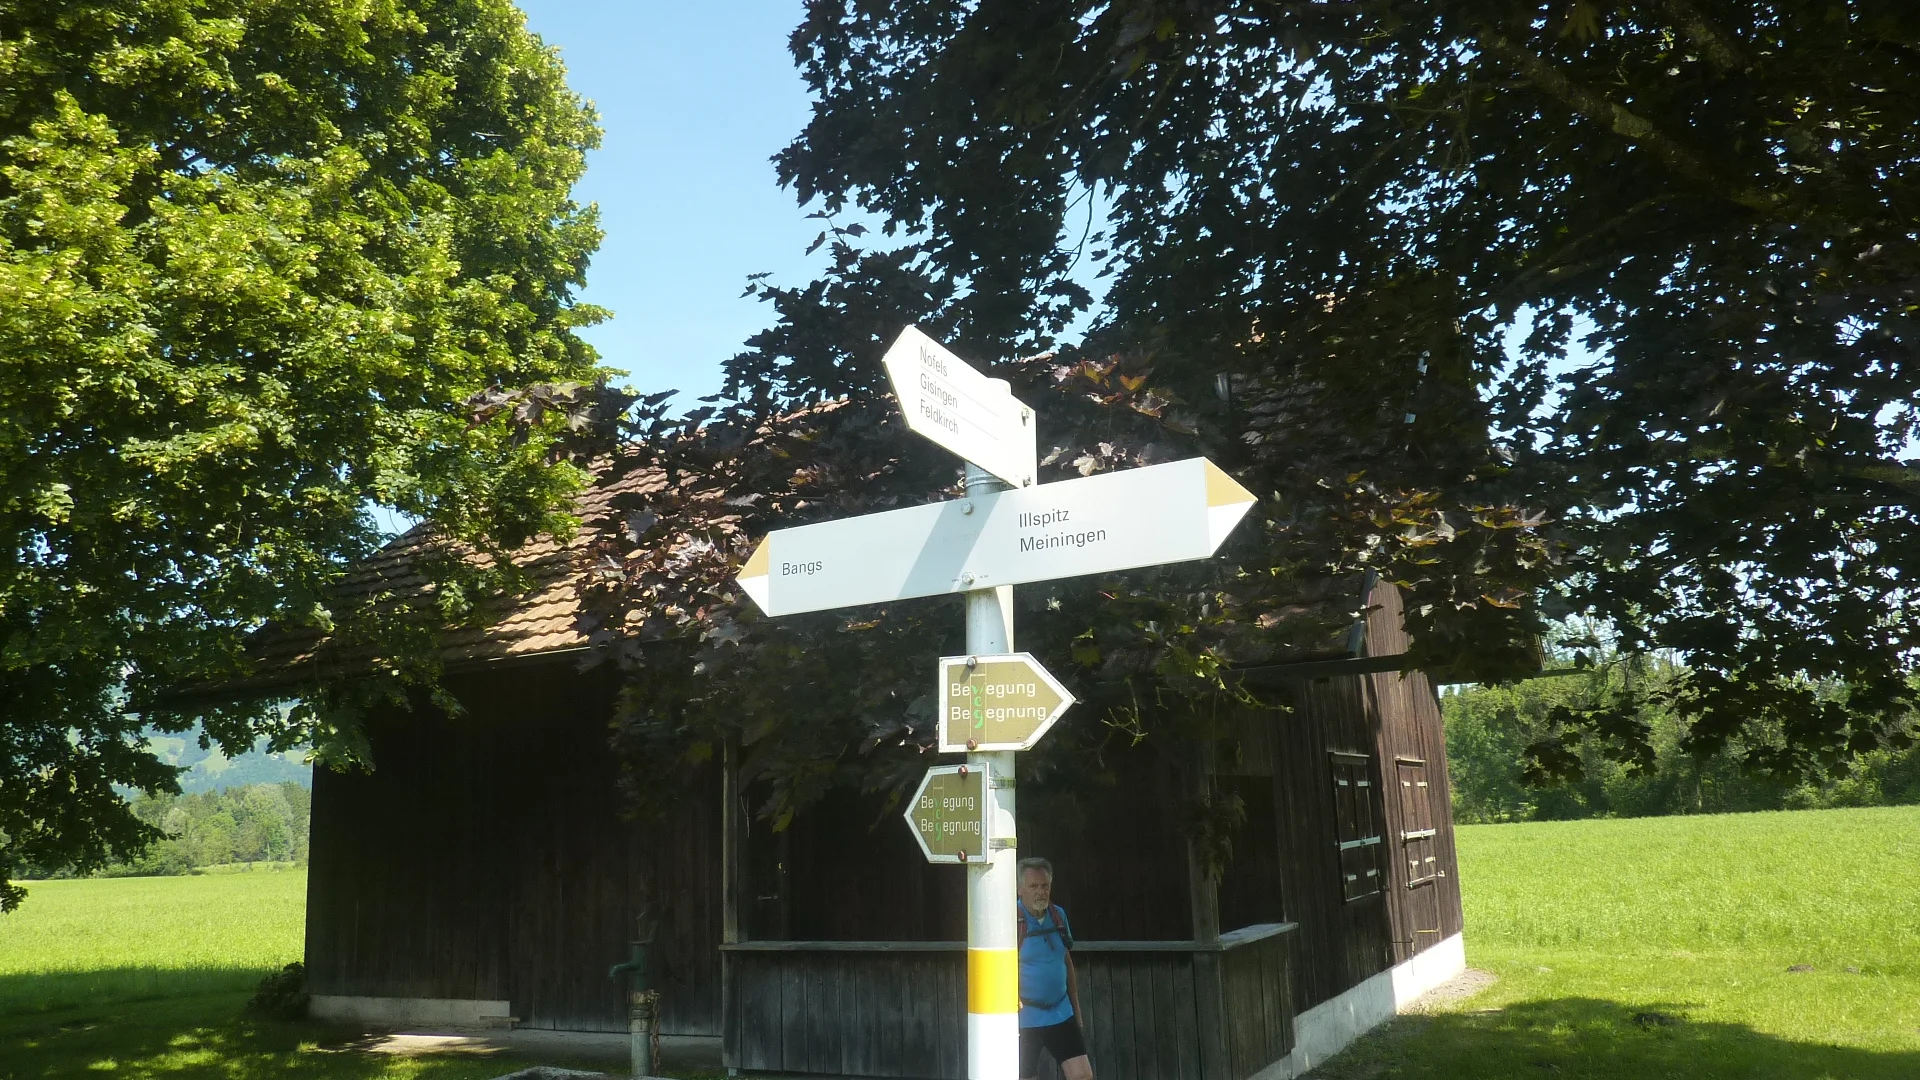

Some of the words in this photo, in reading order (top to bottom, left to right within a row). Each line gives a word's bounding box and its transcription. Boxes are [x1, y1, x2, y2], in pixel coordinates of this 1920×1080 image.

[920, 345, 948, 377] Nofels
[920, 373, 958, 409] Gisingen
[920, 398, 959, 435] Feldkirch
[1019, 508, 1070, 528] Illspitz
[1020, 529, 1106, 552] Meiningen
[782, 560, 823, 576] Bangs
[951, 706, 1047, 728] Begegnung
[921, 818, 981, 839] Begegnung
